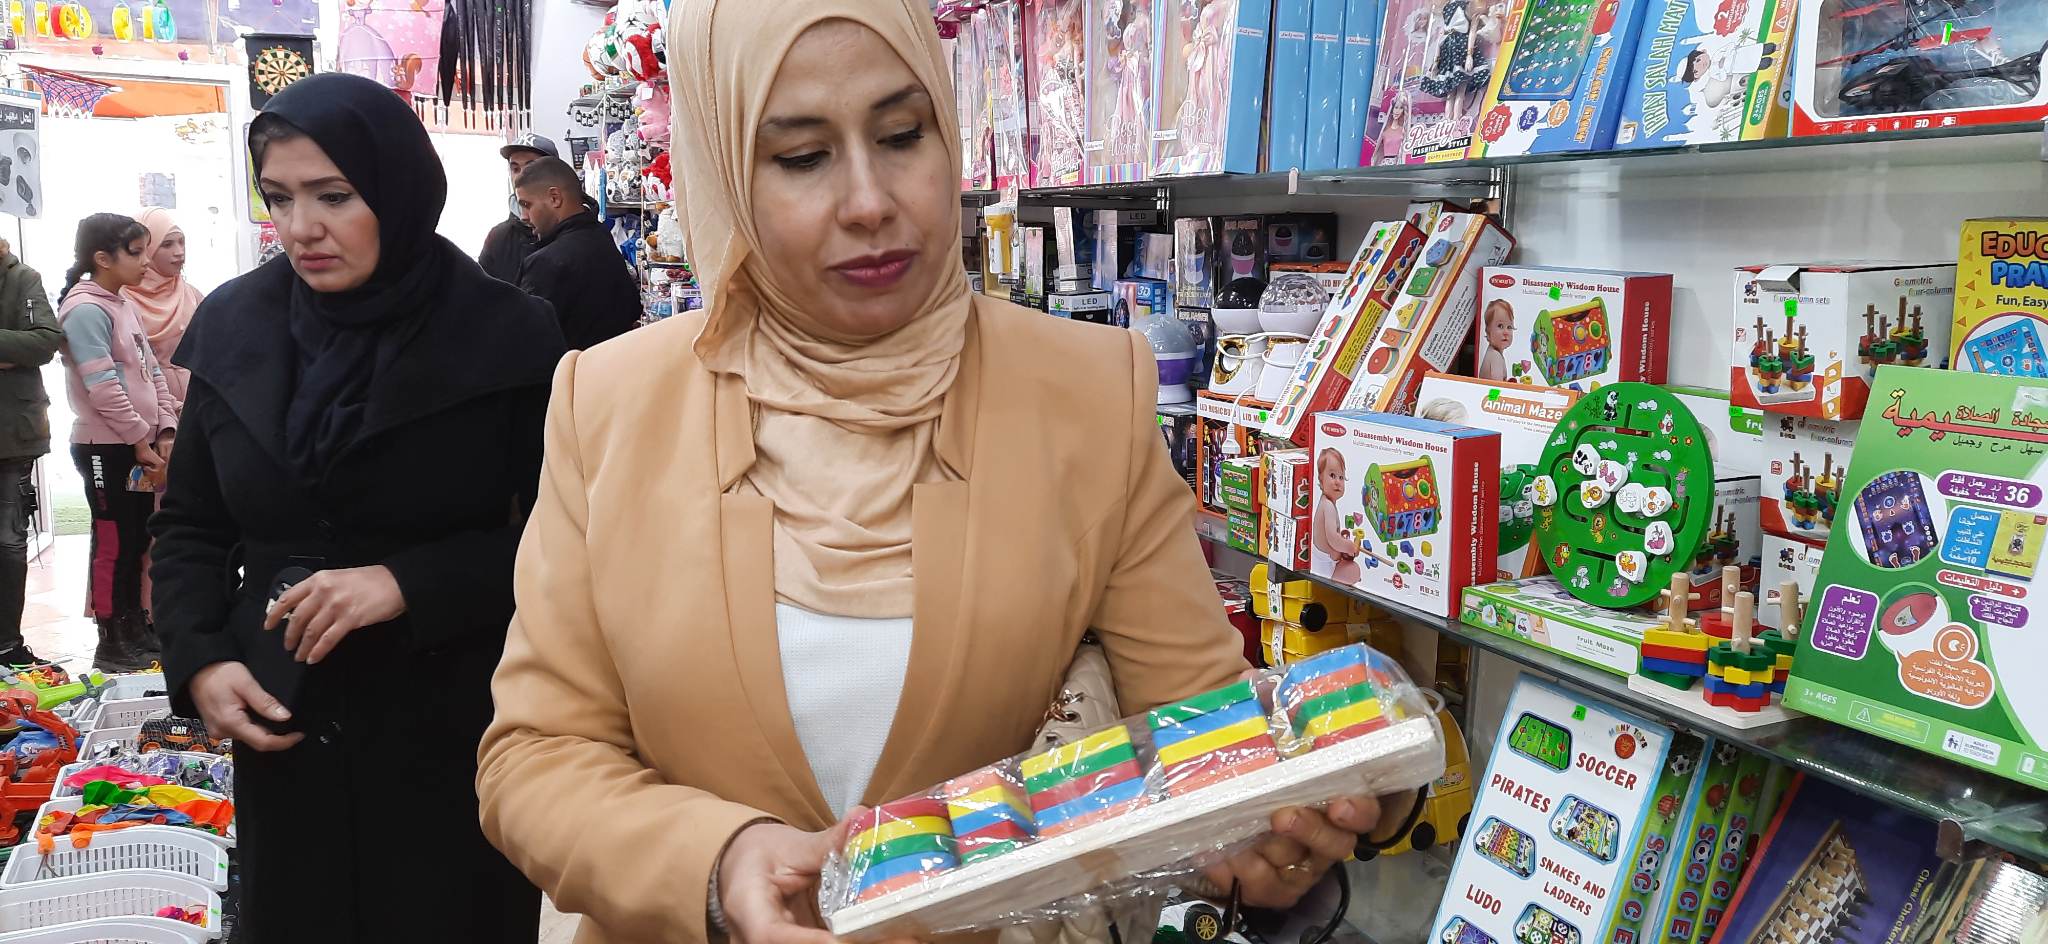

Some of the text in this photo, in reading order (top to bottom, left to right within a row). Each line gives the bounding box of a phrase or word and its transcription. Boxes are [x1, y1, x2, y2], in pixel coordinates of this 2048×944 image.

[1658, 0, 1689, 33] MAT
[1718, 11, 1729, 21] 2
[1644, 35, 1674, 89] SALAH
[1914, 119, 1930, 128] 3D
[1404, 120, 1456, 150] Pretty
[1413, 145, 1439, 156] FASHION
[1448, 138, 1468, 149] STYLE
[1522, 279, 1564, 289] Disassembly
[1566, 282, 1595, 291] Wisdom
[1597, 284, 1620, 293] House
[1894, 276, 1933, 287] Geometric
[1996, 295, 2021, 307] Fun,
[1639, 301, 1651, 373] Wisdom House
[1484, 399, 1563, 420] Animal Maze
[1955, 405, 2000, 424] الصلاة
[1353, 429, 1394, 444] Disassembly
[1395, 437, 1423, 449] Wisdom
[1425, 442, 1448, 453] House
[1952, 436, 2043, 455] سهل مرح وجميل
[91, 455, 104, 489] NIKE
[2004, 486, 2031, 504] 36
[1471, 494, 1479, 535] Wisdom
[1842, 593, 1861, 605] تعلم
[1577, 635, 1593, 646] Fruit
[1596, 640, 1615, 652] Maze
[1815, 692, 1838, 705] AGES
[171, 726, 187, 735] CAR
[1609, 724, 1631, 737] MANY
[1575, 752, 1639, 791] SOCCER
[1490, 773, 1551, 814] PIRATES
[1539, 856, 1606, 900] SNAKES AND
[1466, 884, 1502, 915] LUDO
[1543, 881, 1592, 916] LADDERS
